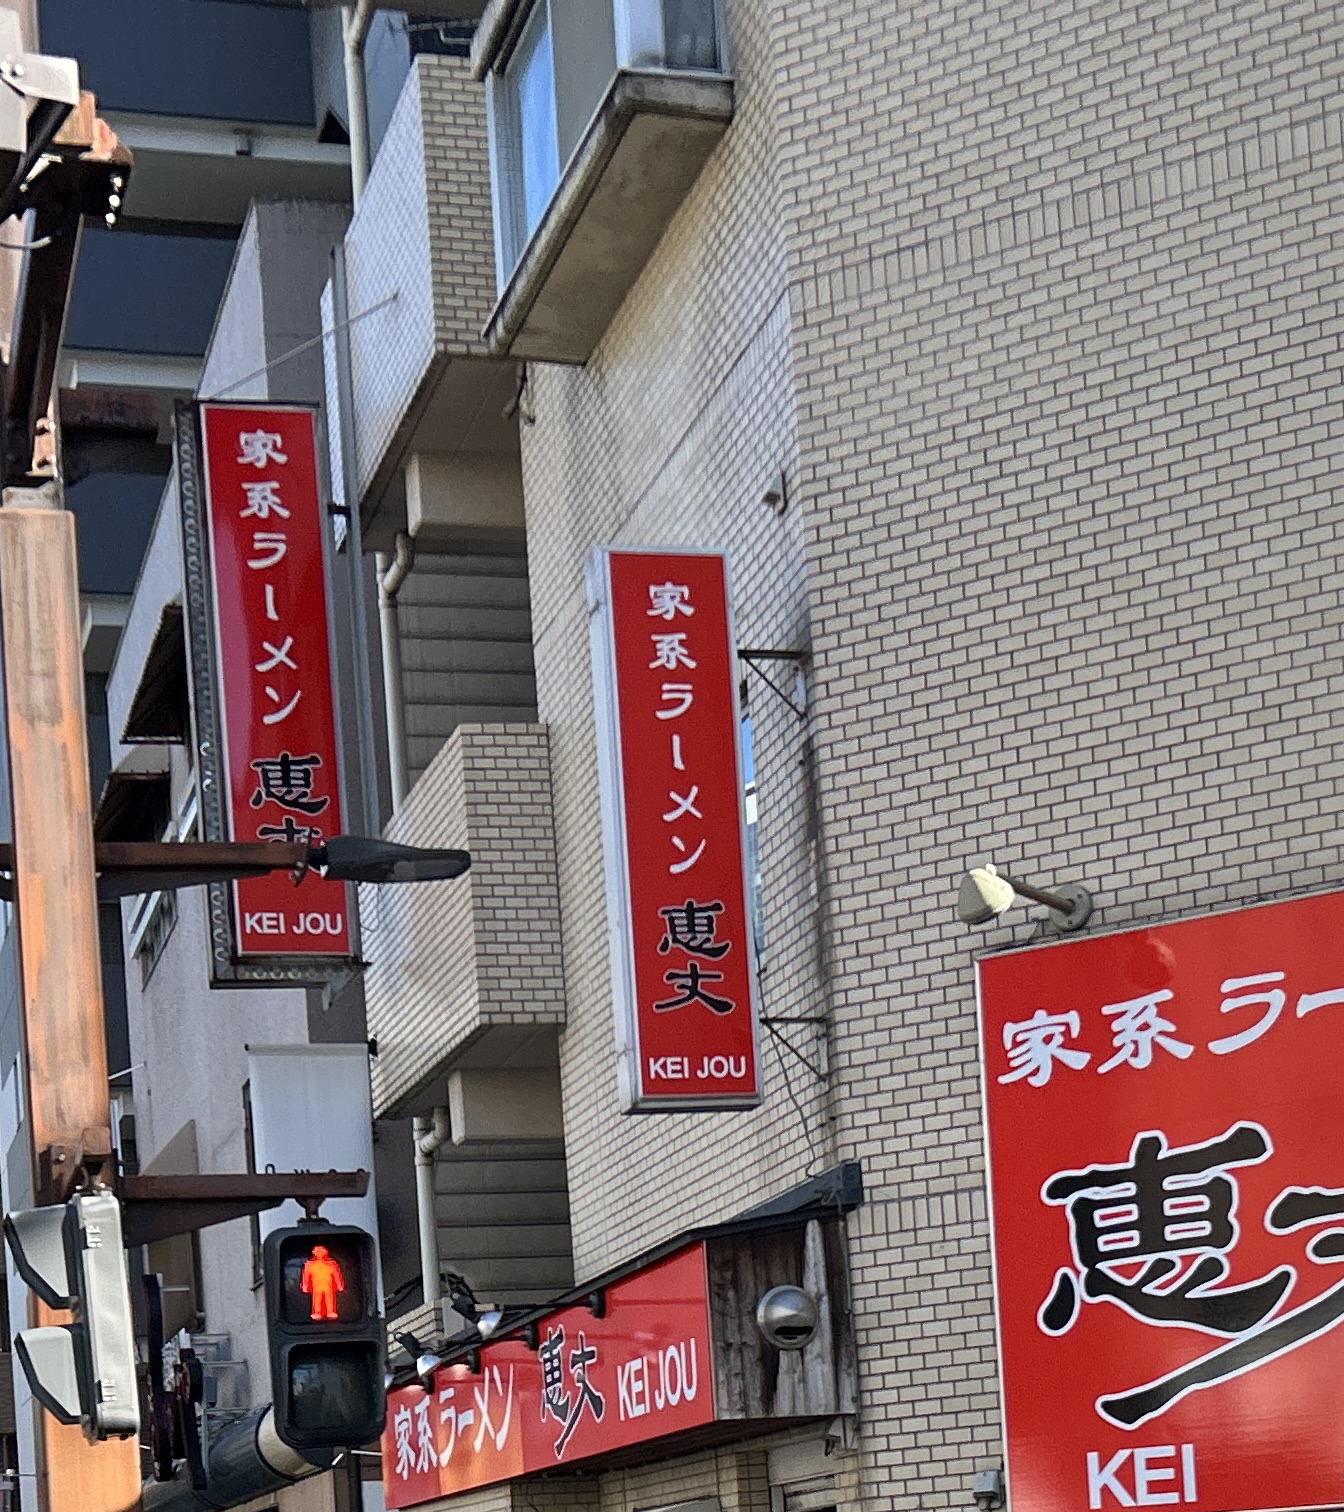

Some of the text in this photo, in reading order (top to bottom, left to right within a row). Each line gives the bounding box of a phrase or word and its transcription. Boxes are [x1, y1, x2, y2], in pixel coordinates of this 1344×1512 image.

[237, 429, 302, 726] 家系ラーメン
[646, 581, 735, 1016] 家系ラーメン 恵丈
[244, 911, 343, 936] KEI JOU
[648, 1055, 747, 1080] KEI JOU
[393, 1323, 699, 1482] 家系ラーメン 恵丈 KEI JOU
[1085, 1443, 1198, 1510] KEI
